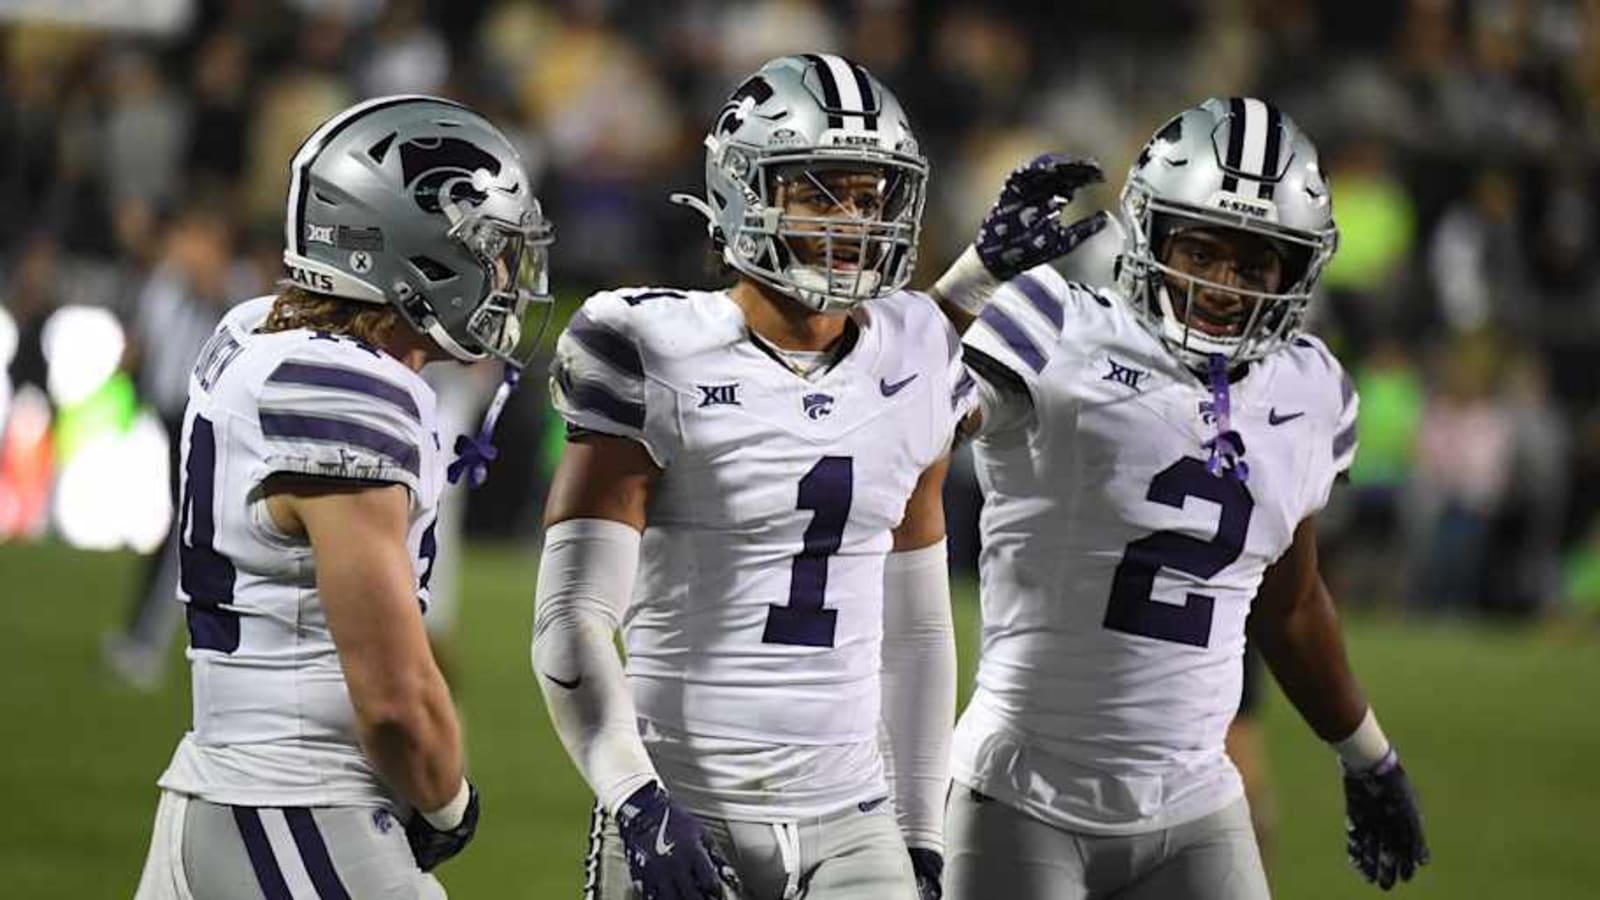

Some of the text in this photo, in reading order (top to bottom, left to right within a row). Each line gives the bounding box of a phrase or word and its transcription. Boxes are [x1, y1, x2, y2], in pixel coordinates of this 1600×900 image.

[697, 383, 741, 408] XII
[1102, 356, 1145, 393] XII
[762, 455, 853, 648] 1
[1103, 455, 1254, 648] 2
